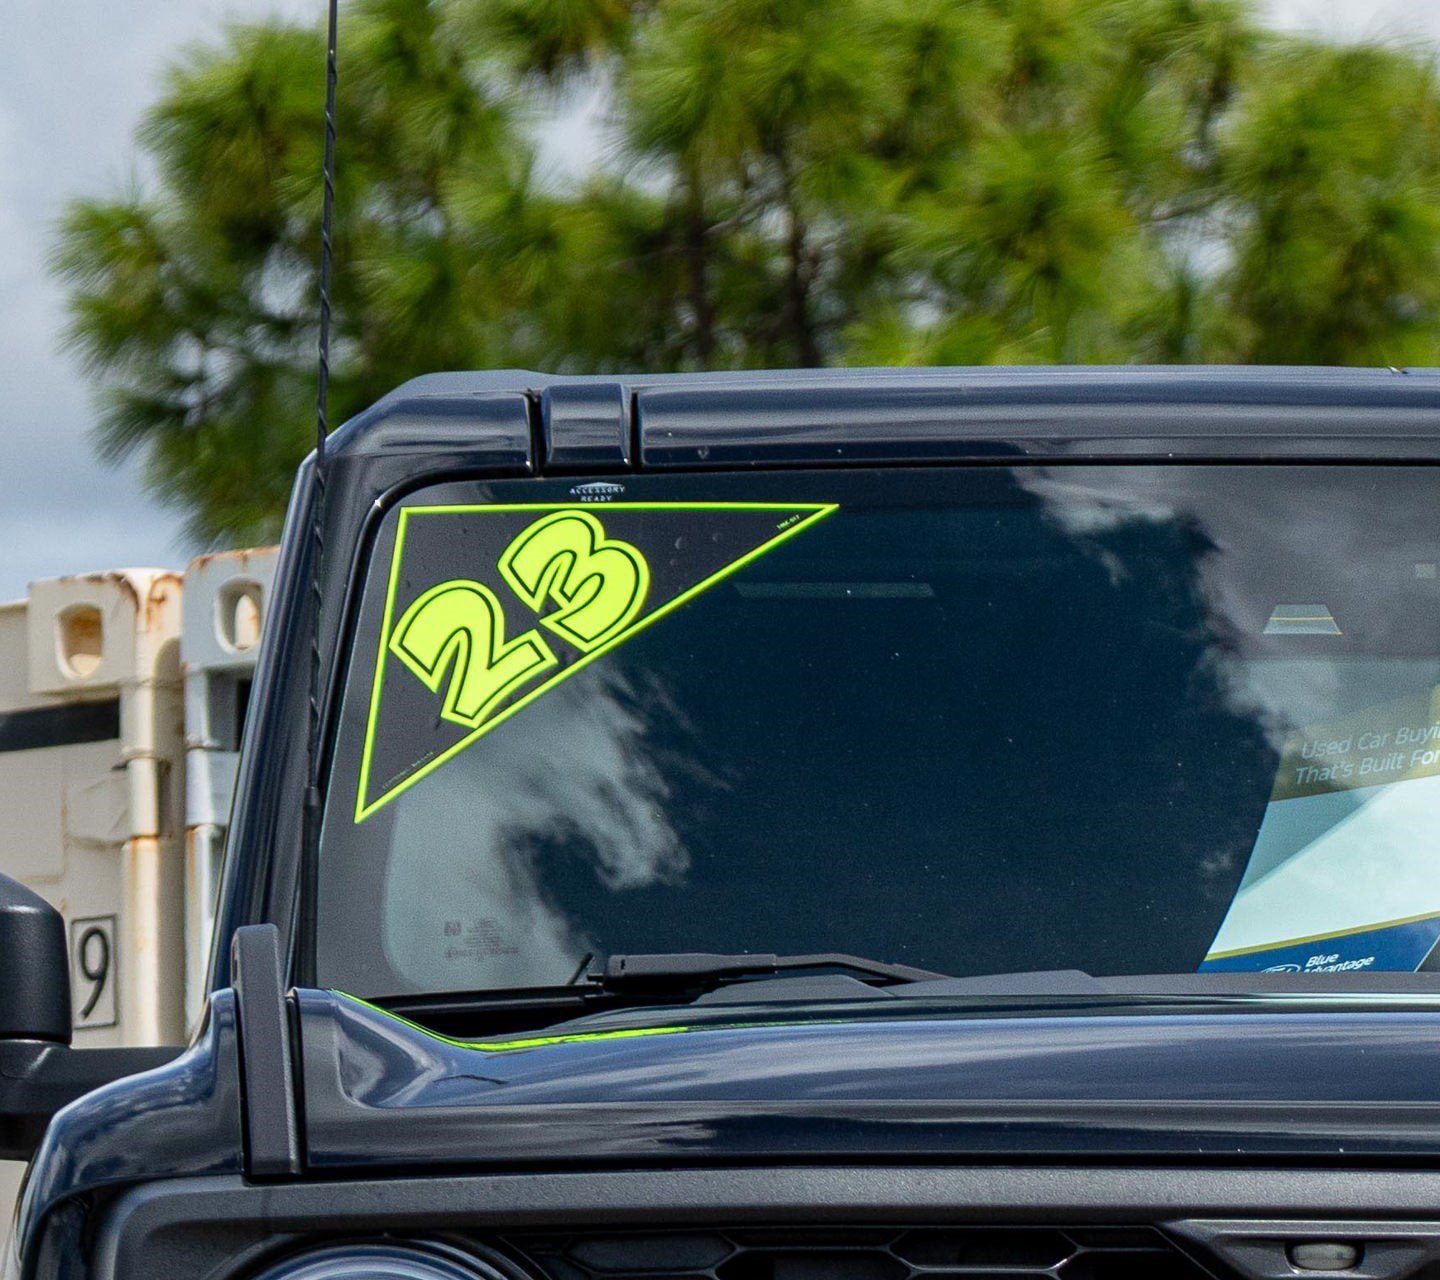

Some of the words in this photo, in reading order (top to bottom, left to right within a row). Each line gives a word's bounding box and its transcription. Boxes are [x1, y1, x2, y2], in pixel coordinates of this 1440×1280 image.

[389, 509, 650, 729] 23
[1301, 735, 1352, 760] Used
[1358, 732, 1388, 750] Car
[1295, 761, 1354, 785] That's
[1359, 753, 1407, 775] Built
[77, 925, 111, 1020] 9
[1305, 953, 1340, 967] Blue
